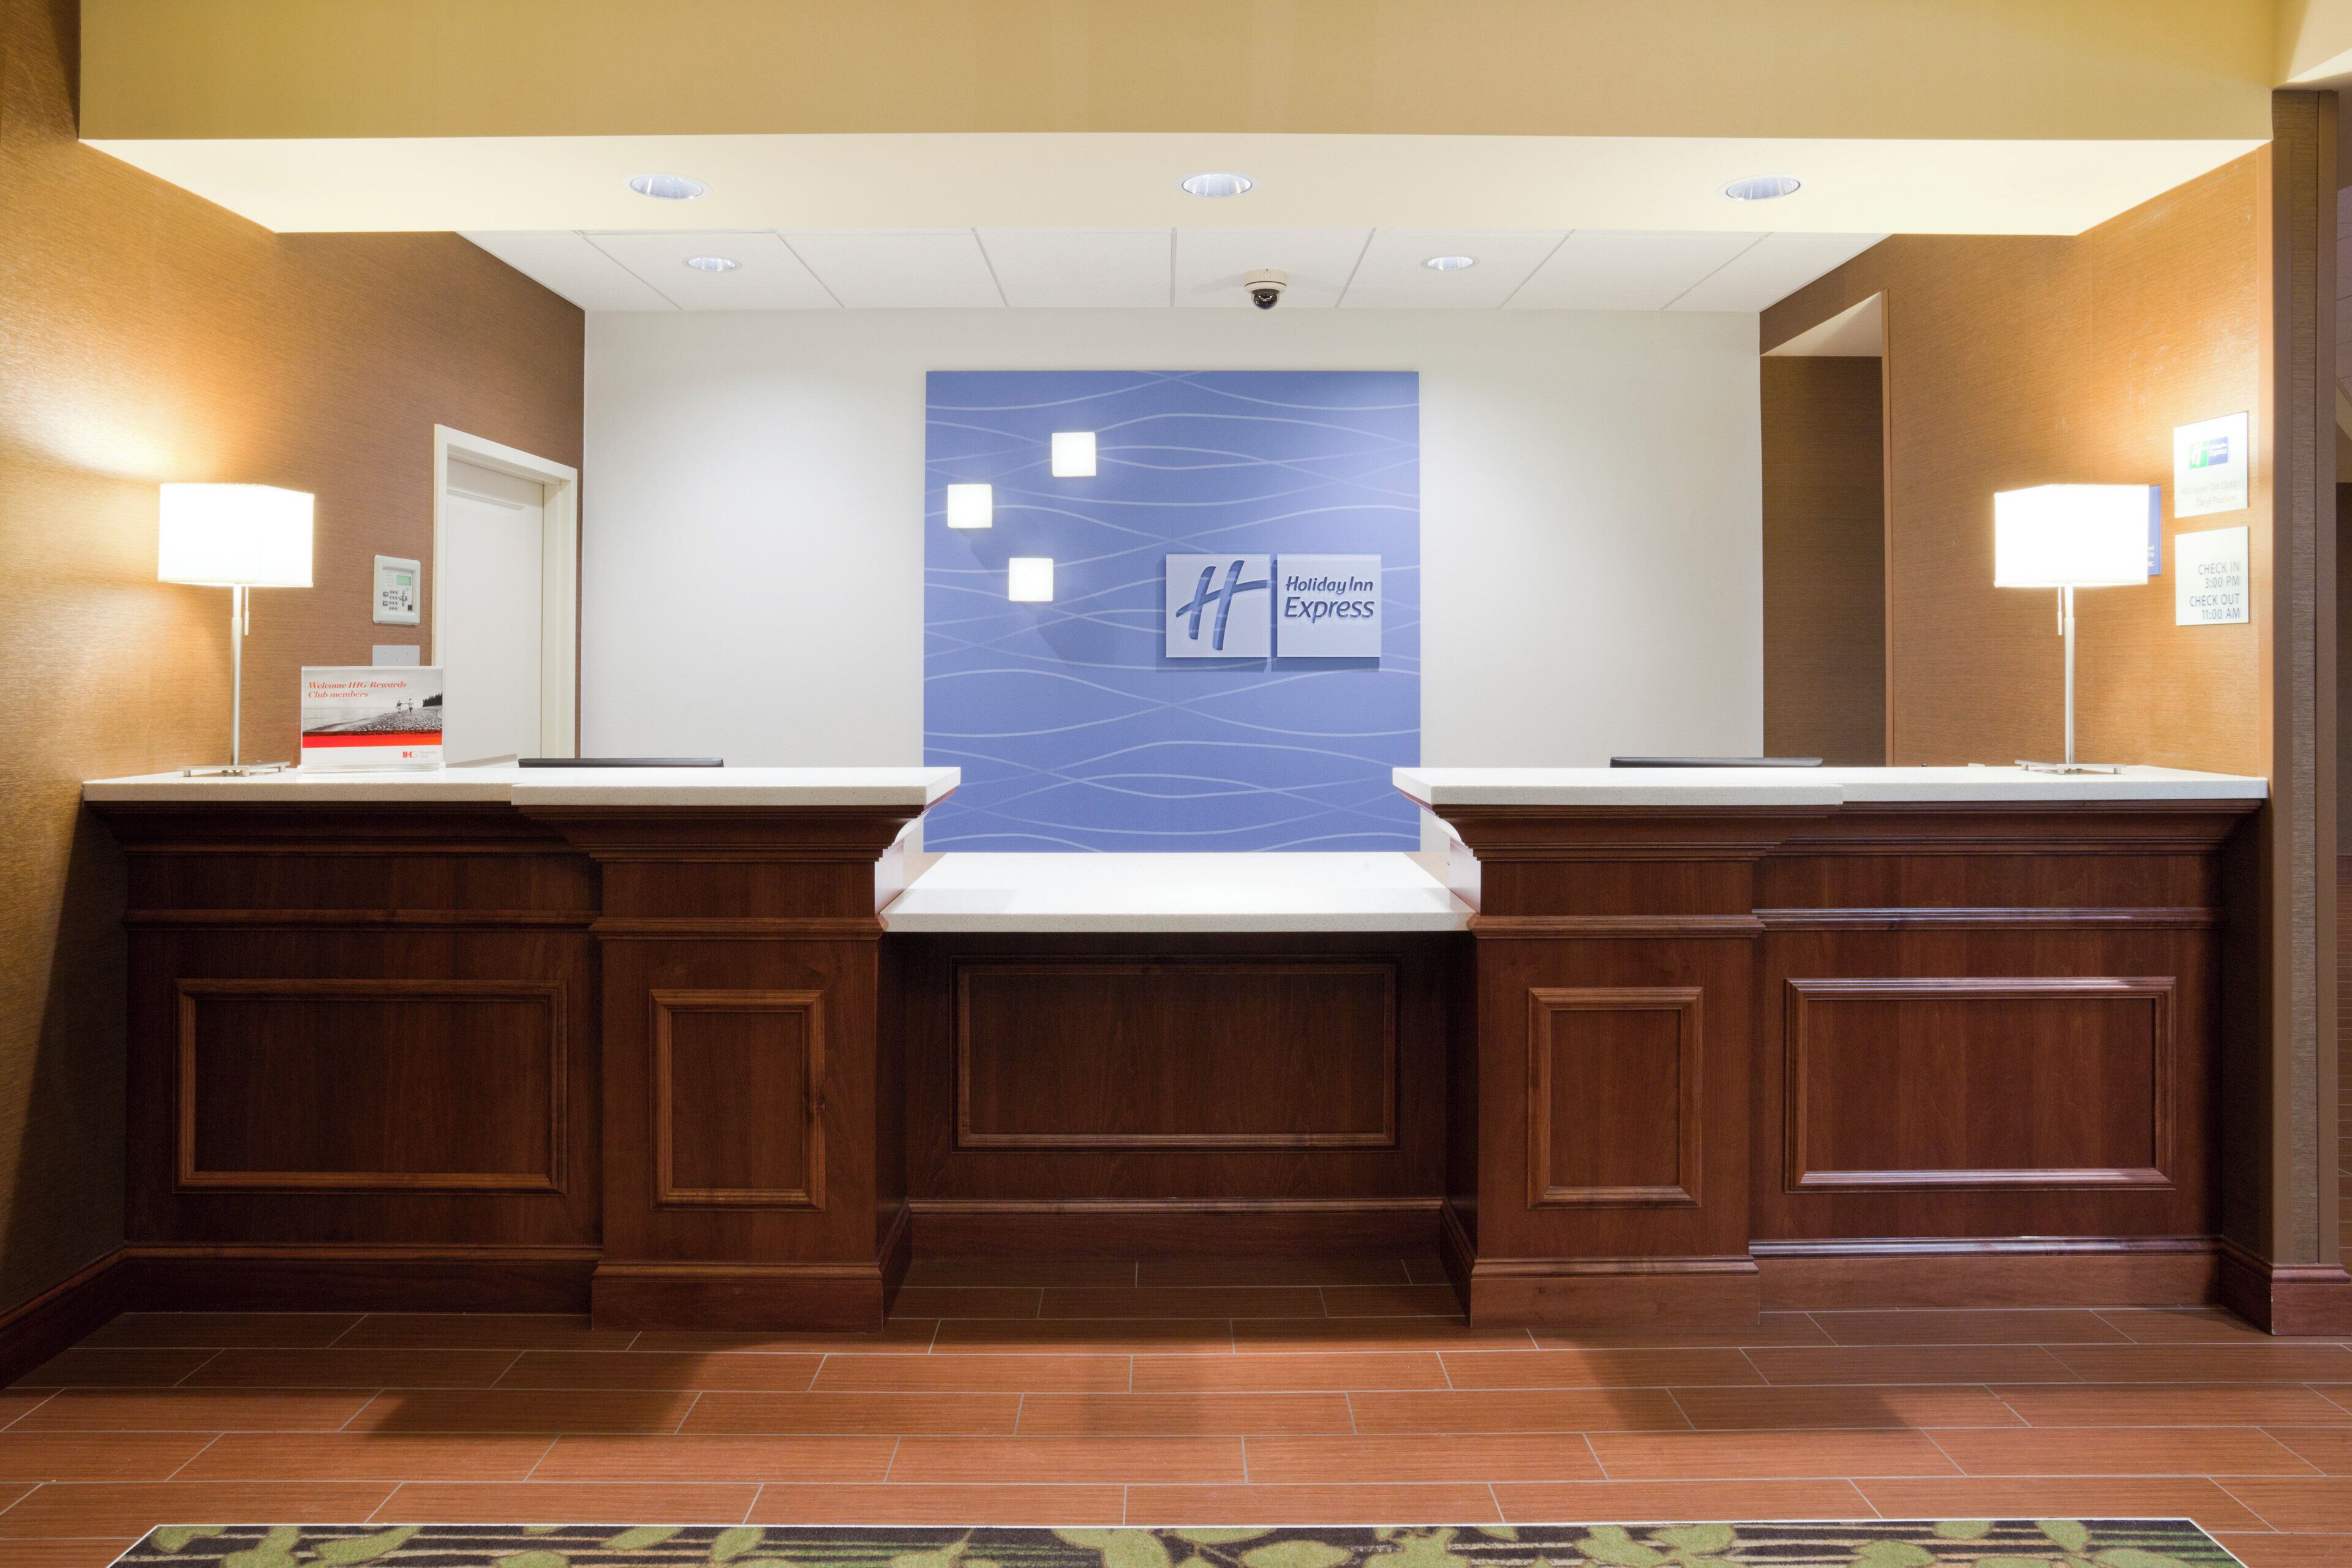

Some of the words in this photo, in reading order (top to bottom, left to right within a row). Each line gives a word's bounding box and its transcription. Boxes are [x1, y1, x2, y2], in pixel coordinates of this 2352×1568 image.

[2198, 562, 2227, 575] CHECK
[2230, 560, 2240, 573] IN
[1285, 575, 1347, 595] Holiday
[1349, 576, 1374, 592] Inn
[2204, 576, 2223, 589] 3:00
[2226, 575, 2240, 587] PM
[2189, 594, 2218, 607] CHECK
[2221, 593, 2240, 605] OUT
[1284, 596, 1375, 624] Express
[2201, 608, 2223, 620] 11:00
[2225, 607, 2240, 619] AM
